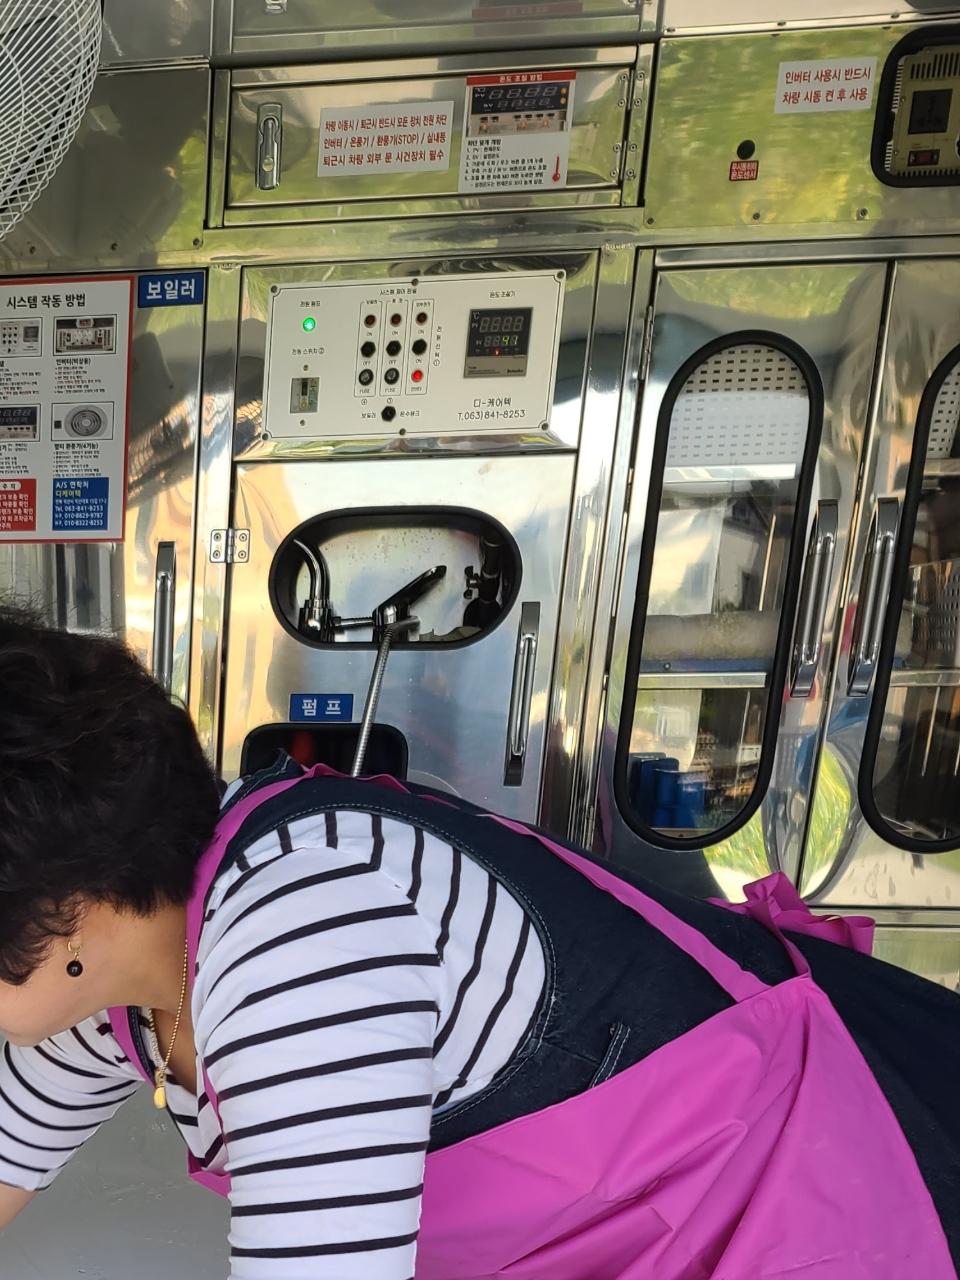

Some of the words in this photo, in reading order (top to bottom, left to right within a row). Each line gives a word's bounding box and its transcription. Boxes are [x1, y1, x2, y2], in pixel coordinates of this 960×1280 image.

[785, 70, 811, 84] 인버터
[814, 69, 841, 83] 사용시
[844, 67, 871, 81] 반드시
[782, 91, 800, 105] 차량
[804, 90, 822, 103] 시동
[825, 89, 834, 102] 켠
[837, 88, 846, 101] 후
[850, 87, 868, 100] 사용
[325, 120, 336, 132] 차량
[338, 120, 354, 131] 이동시
[360, 118, 378, 130] 퇴근시
[378, 117, 396, 128] 반드시
[397, 116, 408, 127] 모든
[410, 116, 421, 127] 장치
[423, 115, 434, 127] 전원
[436, 114, 447, 126] 차단
[324, 138, 342, 149] 인버터
[350, 137, 369, 148] 온풍기
[427, 132, 447, 144] 실내등
[323, 155, 346, 167] 퇴근시
[348, 154, 363, 166] 차량
[367, 152, 382, 165] 외부
[385, 152, 392, 163] 문
[396, 151, 426, 163] 시건장치
[429, 149, 444, 161] 필수
[147, 278, 196, 300] 보일러
[6, 296, 38, 310] 시스템
[40, 295, 62, 308] 작동
[65, 293, 86, 307] 방법
[70, 481, 88, 489] 연락처
